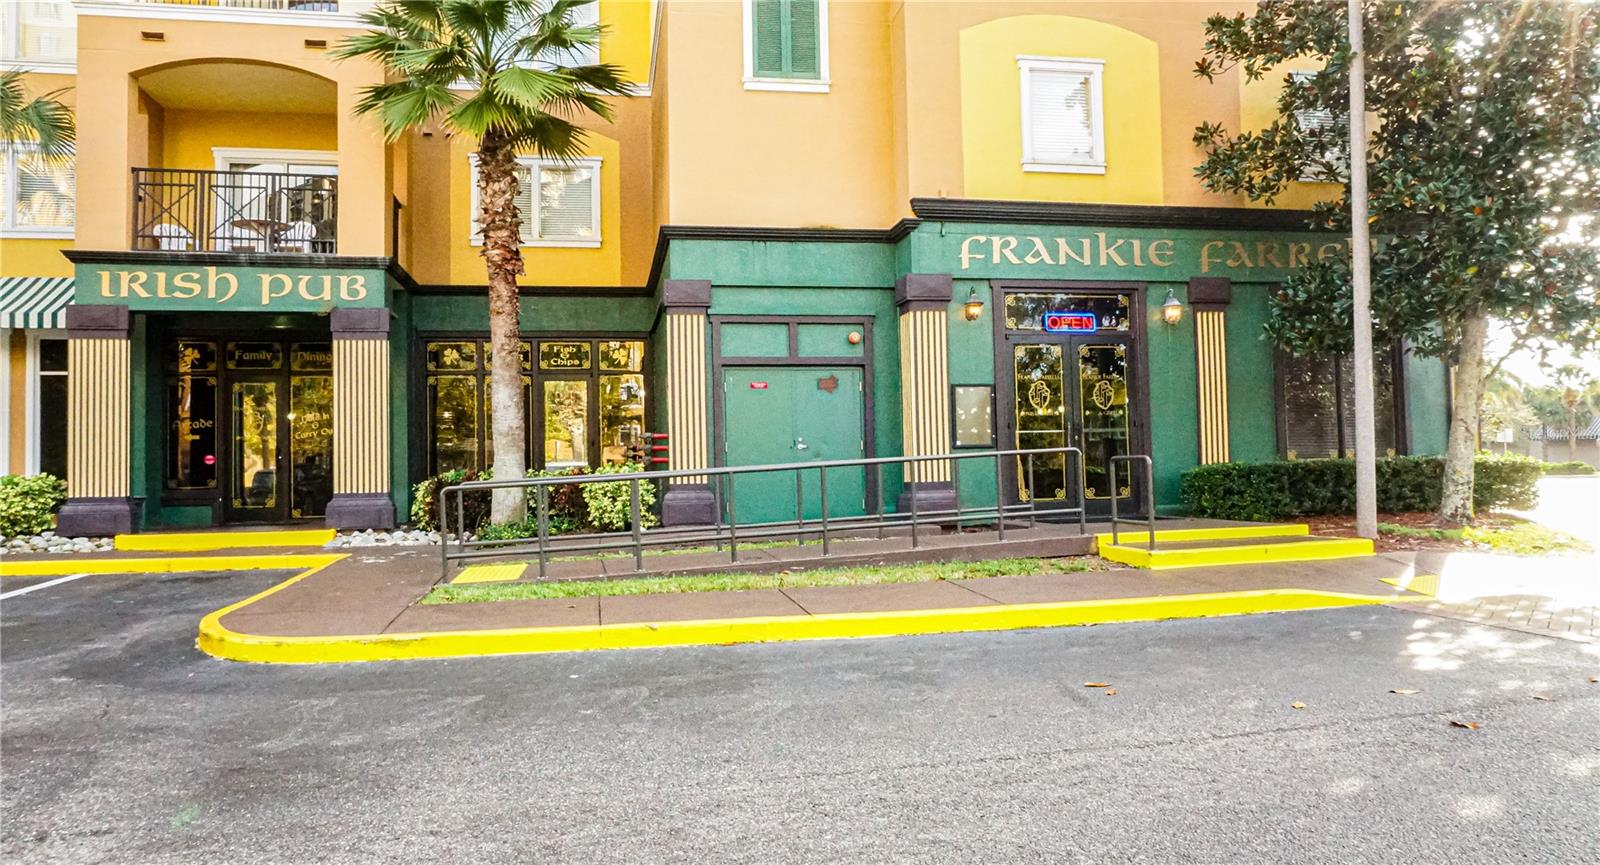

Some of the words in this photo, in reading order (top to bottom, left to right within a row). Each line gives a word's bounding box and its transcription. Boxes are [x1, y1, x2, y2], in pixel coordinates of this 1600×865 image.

[958, 232, 1176, 271] FRANKIE
[96, 265, 239, 304] IRISH
[257, 272, 369, 305] PUB
[1048, 316, 1093, 329] OPEN
[553, 345, 577, 353] Fish
[234, 350, 273, 362] Family
[550, 358, 580, 367] Chips
[295, 431, 318, 440] Carry
